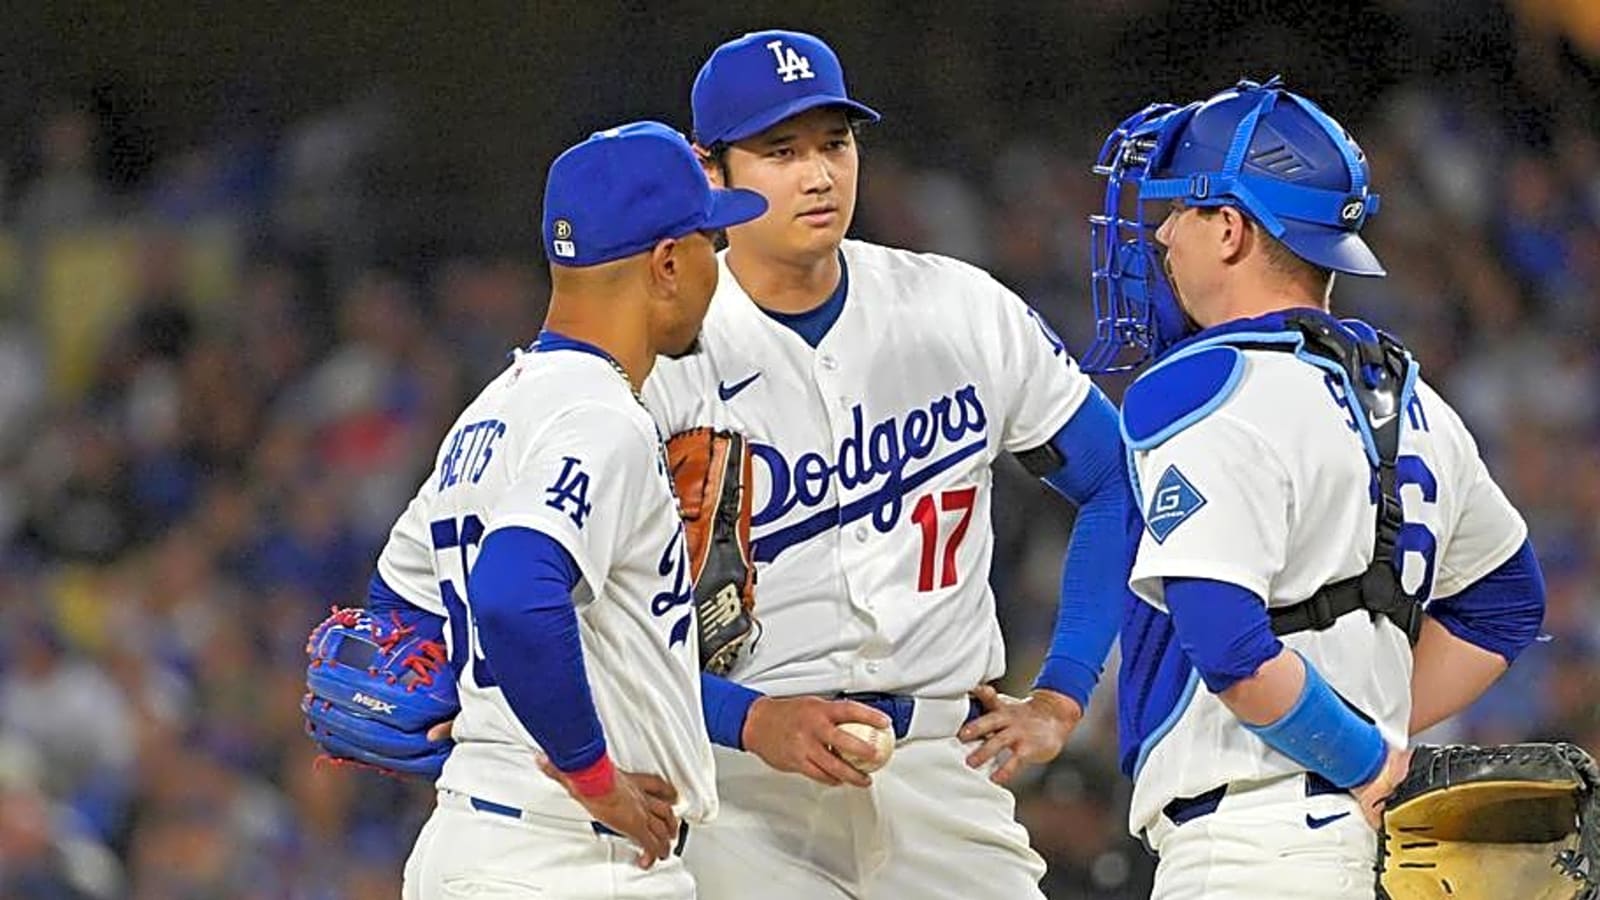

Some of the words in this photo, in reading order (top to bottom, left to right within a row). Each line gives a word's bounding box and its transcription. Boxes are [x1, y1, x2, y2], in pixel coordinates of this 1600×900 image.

[767, 40, 815, 82] LA
[438, 419, 506, 492] BETTS
[750, 384, 987, 533] Dodgers
[546, 456, 592, 529] LA
[1156, 485, 1181, 513] G
[911, 486, 978, 593] 17
[1369, 455, 1438, 606] 6
